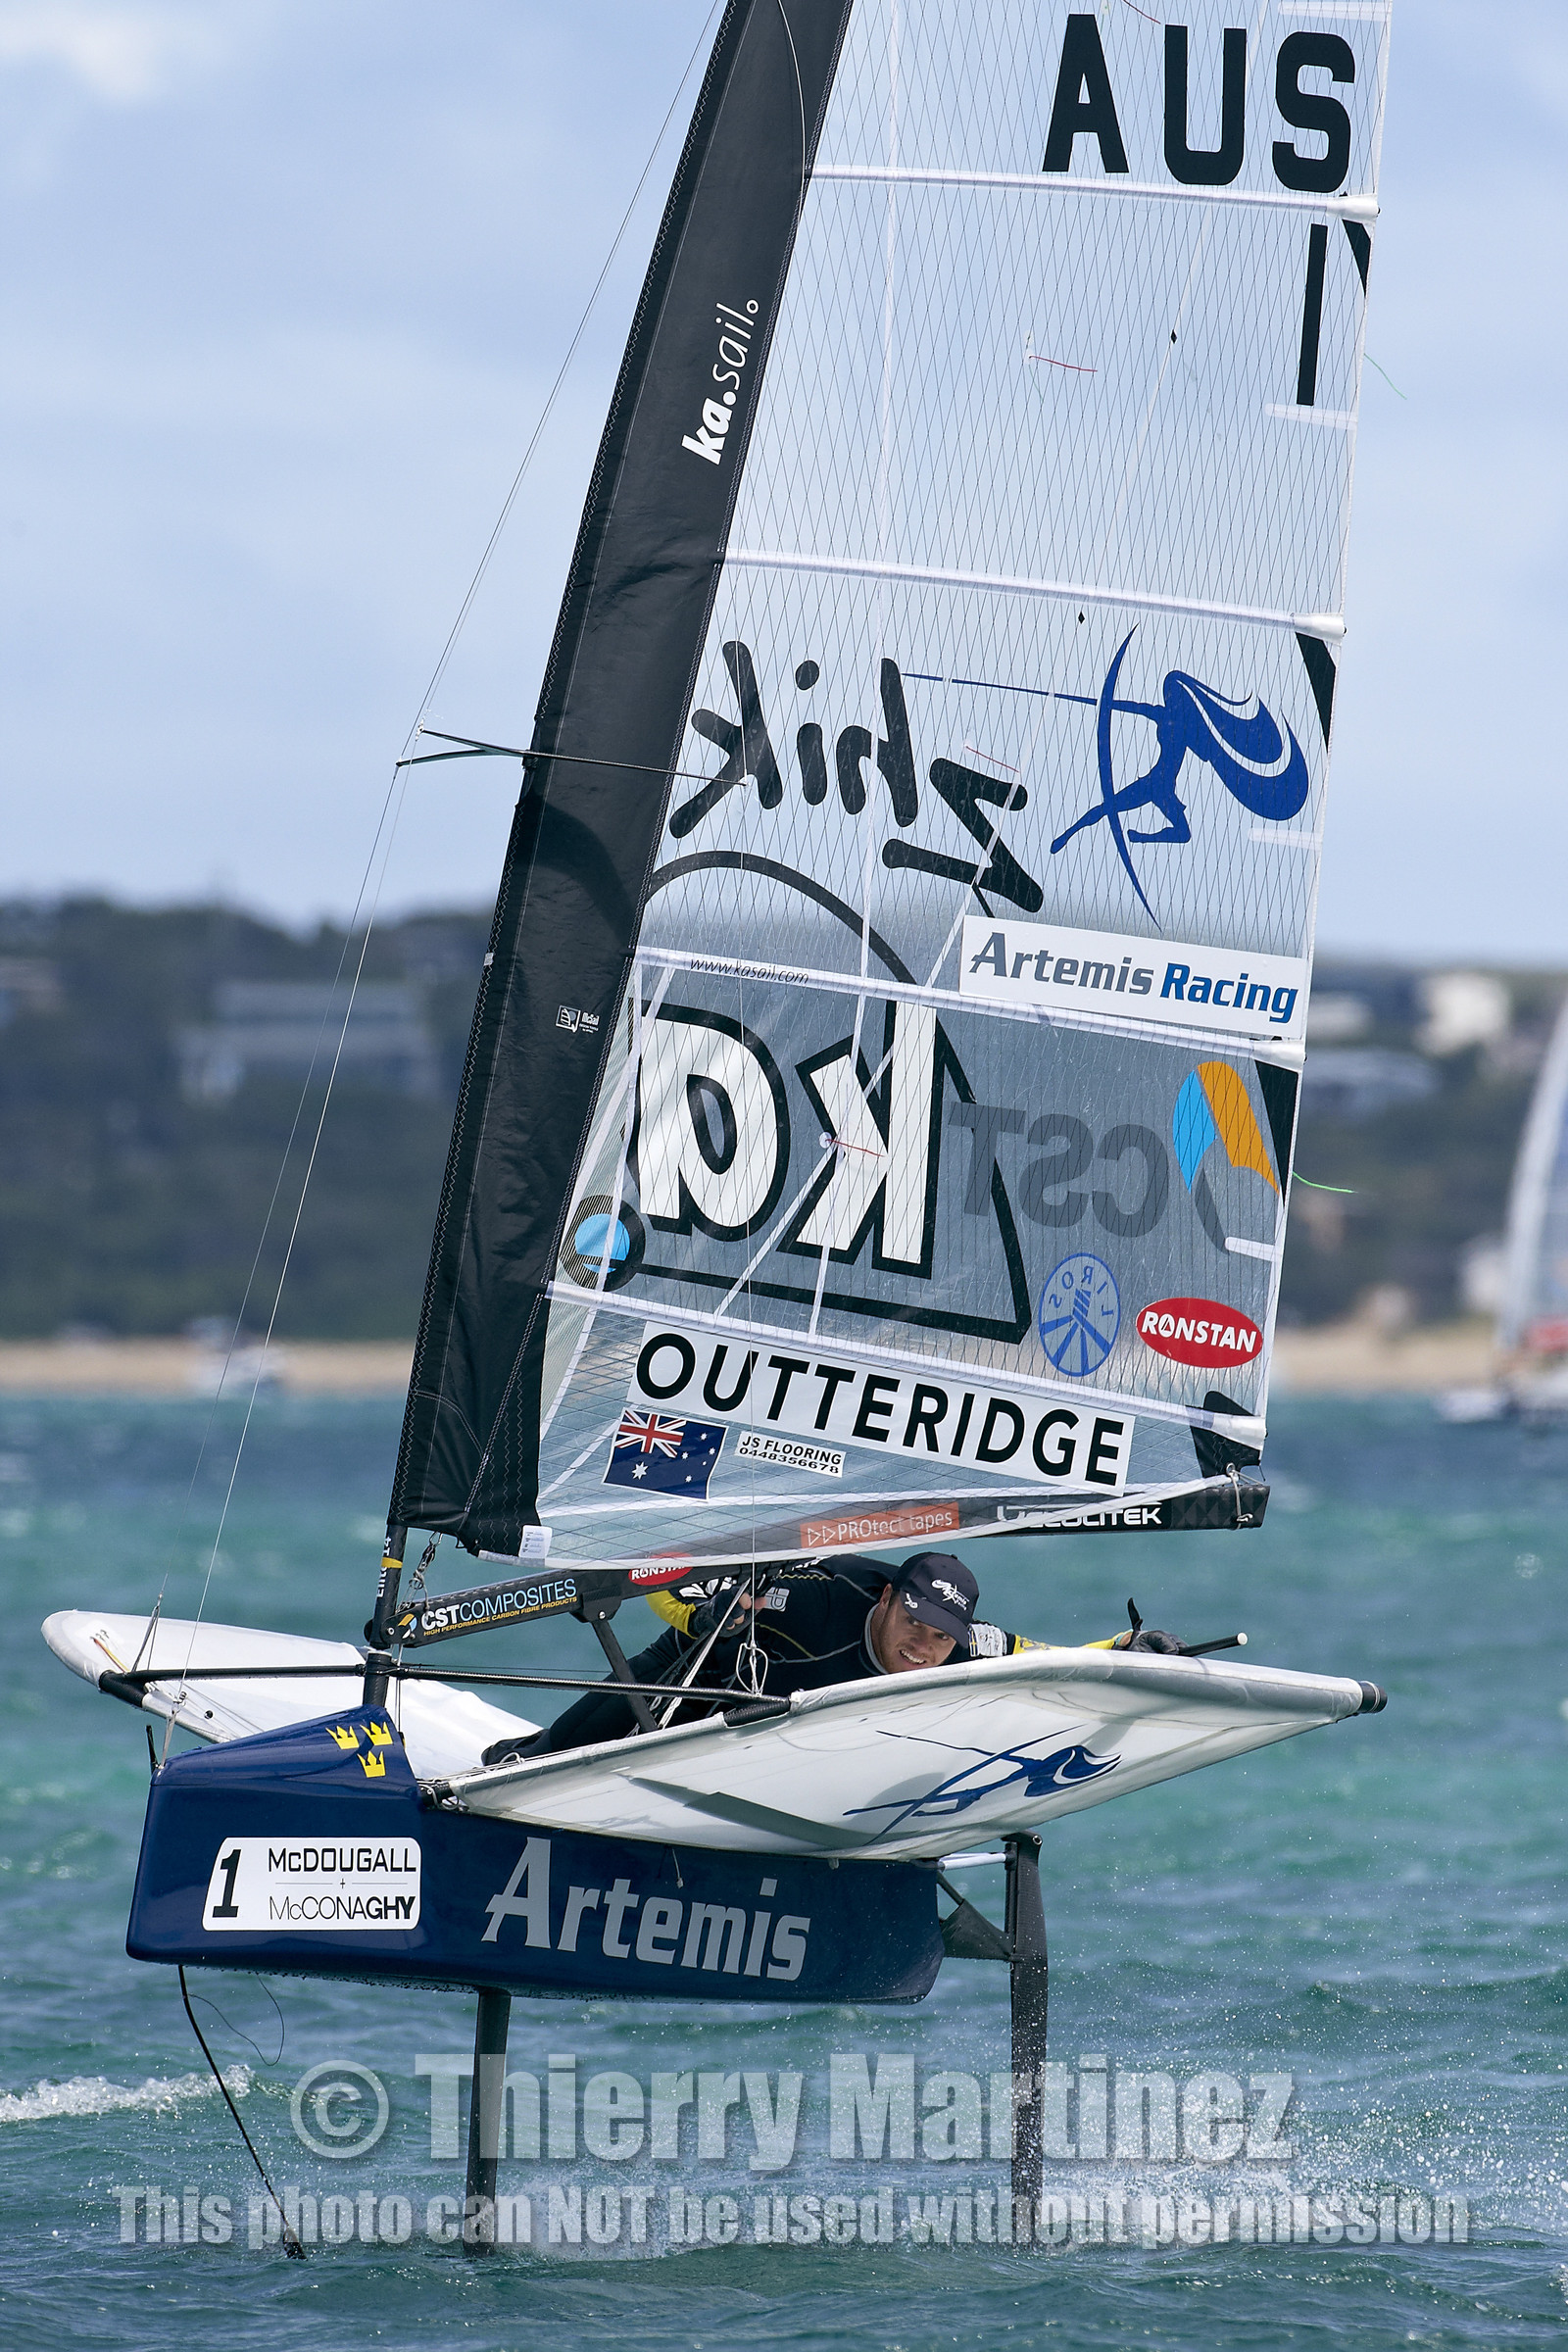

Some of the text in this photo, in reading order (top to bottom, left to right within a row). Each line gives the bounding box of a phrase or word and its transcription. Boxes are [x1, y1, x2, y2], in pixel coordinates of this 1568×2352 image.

[1042, 14, 1355, 193] AUS
[690, 958, 809, 985] www.kasail.com
[969, 931, 1298, 1024] Artemis Racing
[1141, 1310, 1257, 1353] RONSTAN
[636, 1332, 1125, 1487] OUTTERIDGE
[739, 1446, 839, 1474] 0448356678
[742, 1436, 841, 1465] JS FLOORING
[909, 1511, 953, 1533] tapes
[423, 1596, 577, 1637] HIGH PERFORMANCE CARBON FIBRE PRODUCTS
[268, 1847, 417, 1873] McDOUGALL
[212, 1848, 242, 1918] 1
[270, 1895, 416, 1920] McCONAGHY
[480, 1836, 811, 1982] Artemis
